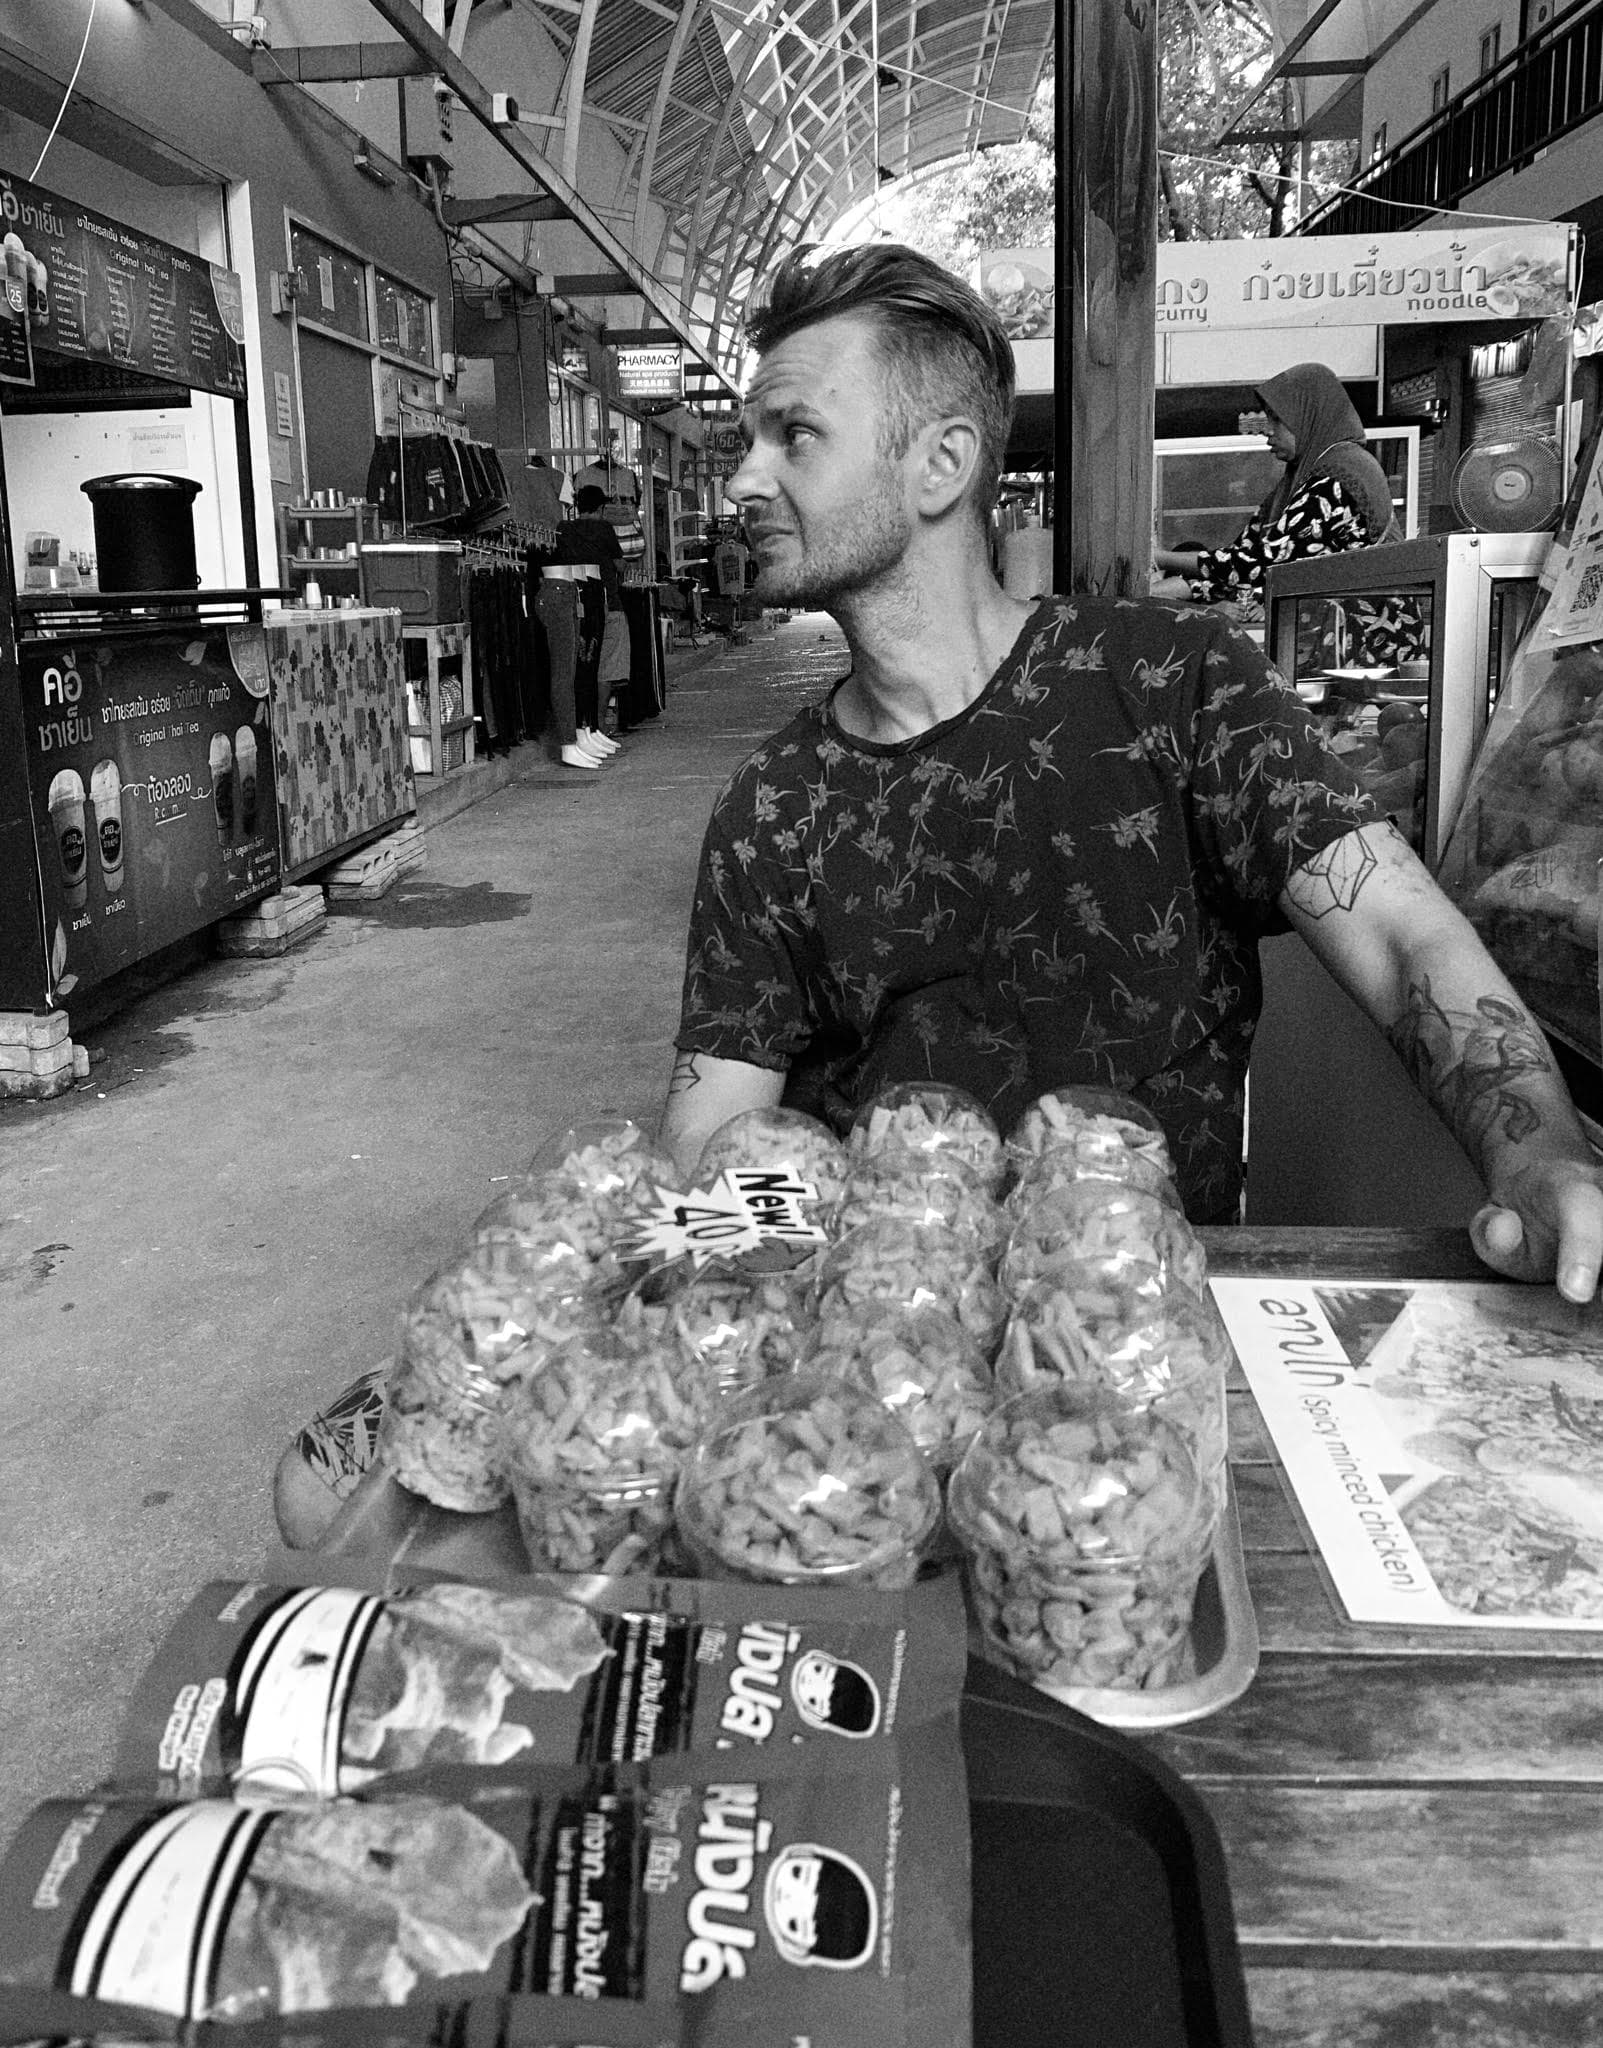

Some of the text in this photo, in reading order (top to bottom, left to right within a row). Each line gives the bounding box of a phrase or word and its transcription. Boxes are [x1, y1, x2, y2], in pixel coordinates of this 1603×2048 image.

[21, 202, 64, 238] ชาเย็น
[1156, 242, 1490, 304] กง ก๋วยเตี๋ยวน้ำ
[1156, 293, 1488, 323] curry noodle
[617, 354, 680, 366] PHARMACY
[38, 705, 93, 751] ชาเย็น
[134, 725, 166, 746] Original
[147, 774, 192, 804] ต้องลอง
[735, 1174, 815, 1235] New!
[1260, 1299, 1372, 1388] ลาบไก่
[1299, 1394, 1427, 1592] (Spicy minced chicken)
